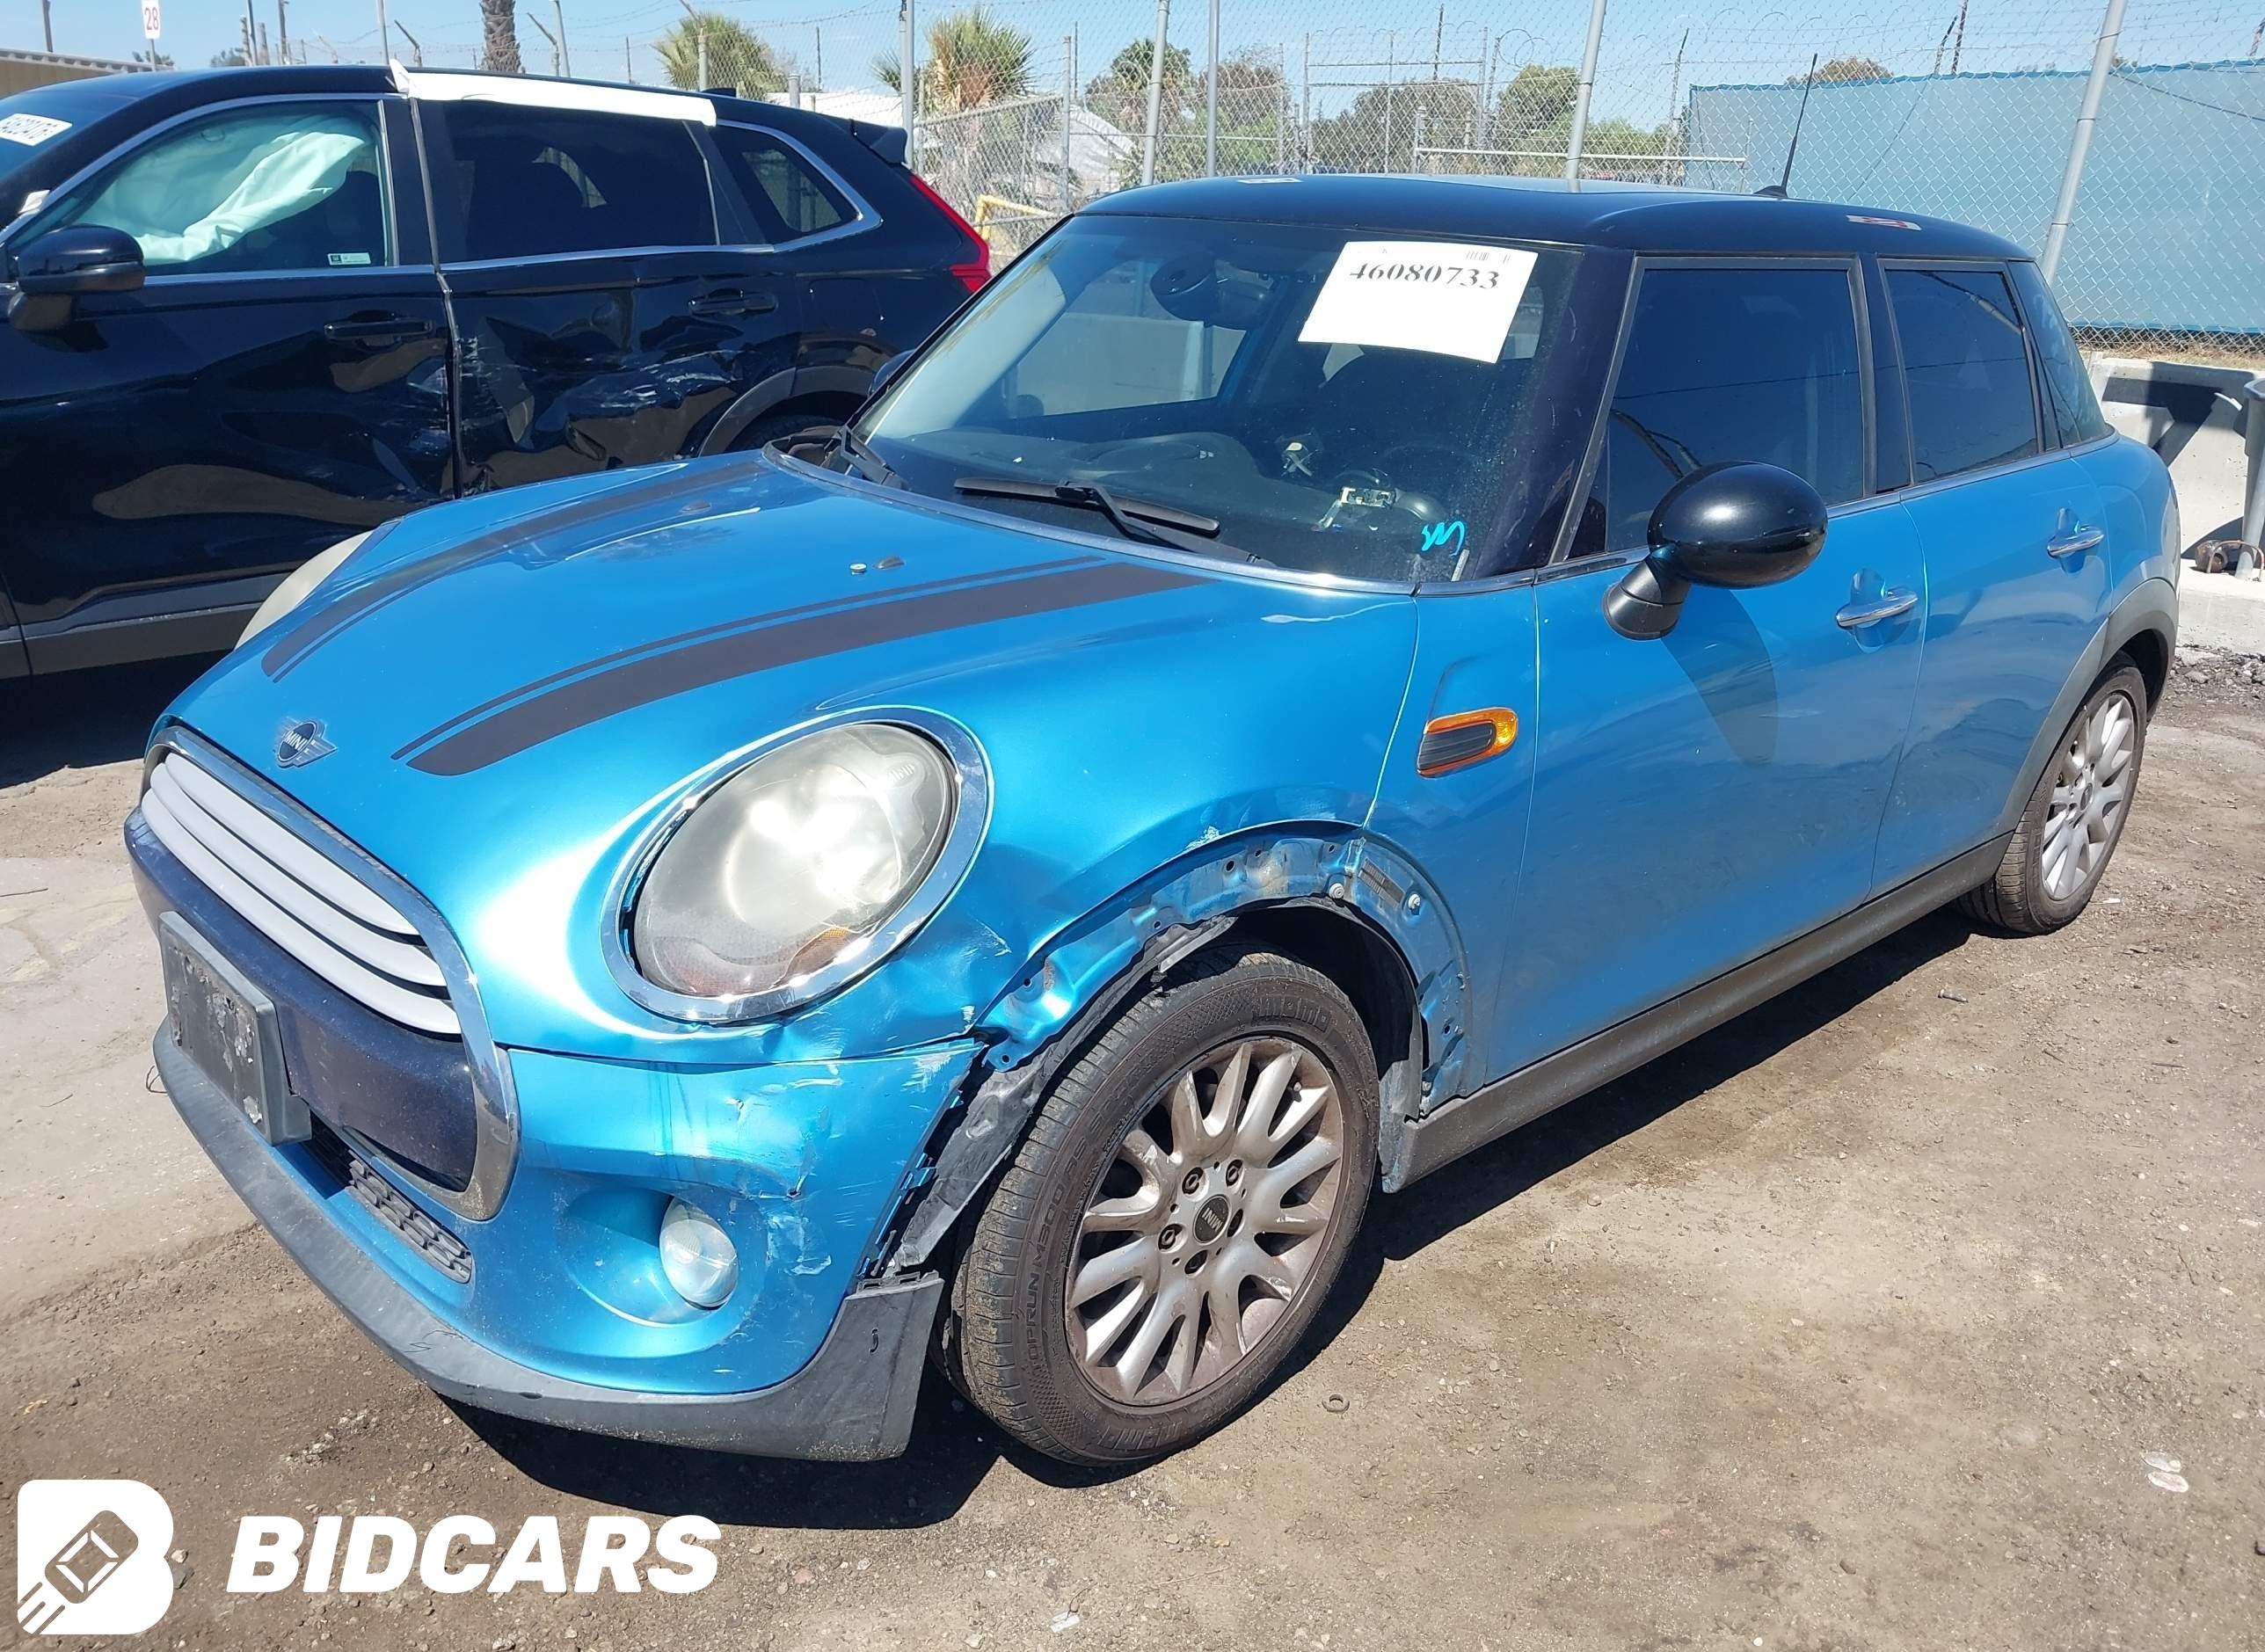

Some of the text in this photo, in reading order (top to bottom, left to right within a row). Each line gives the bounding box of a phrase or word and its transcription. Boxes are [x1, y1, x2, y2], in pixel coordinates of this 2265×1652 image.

[144, 7, 158, 31] 28
[1349, 262, 1500, 290] 46080733
[1200, 1206, 1224, 1233] MINI
